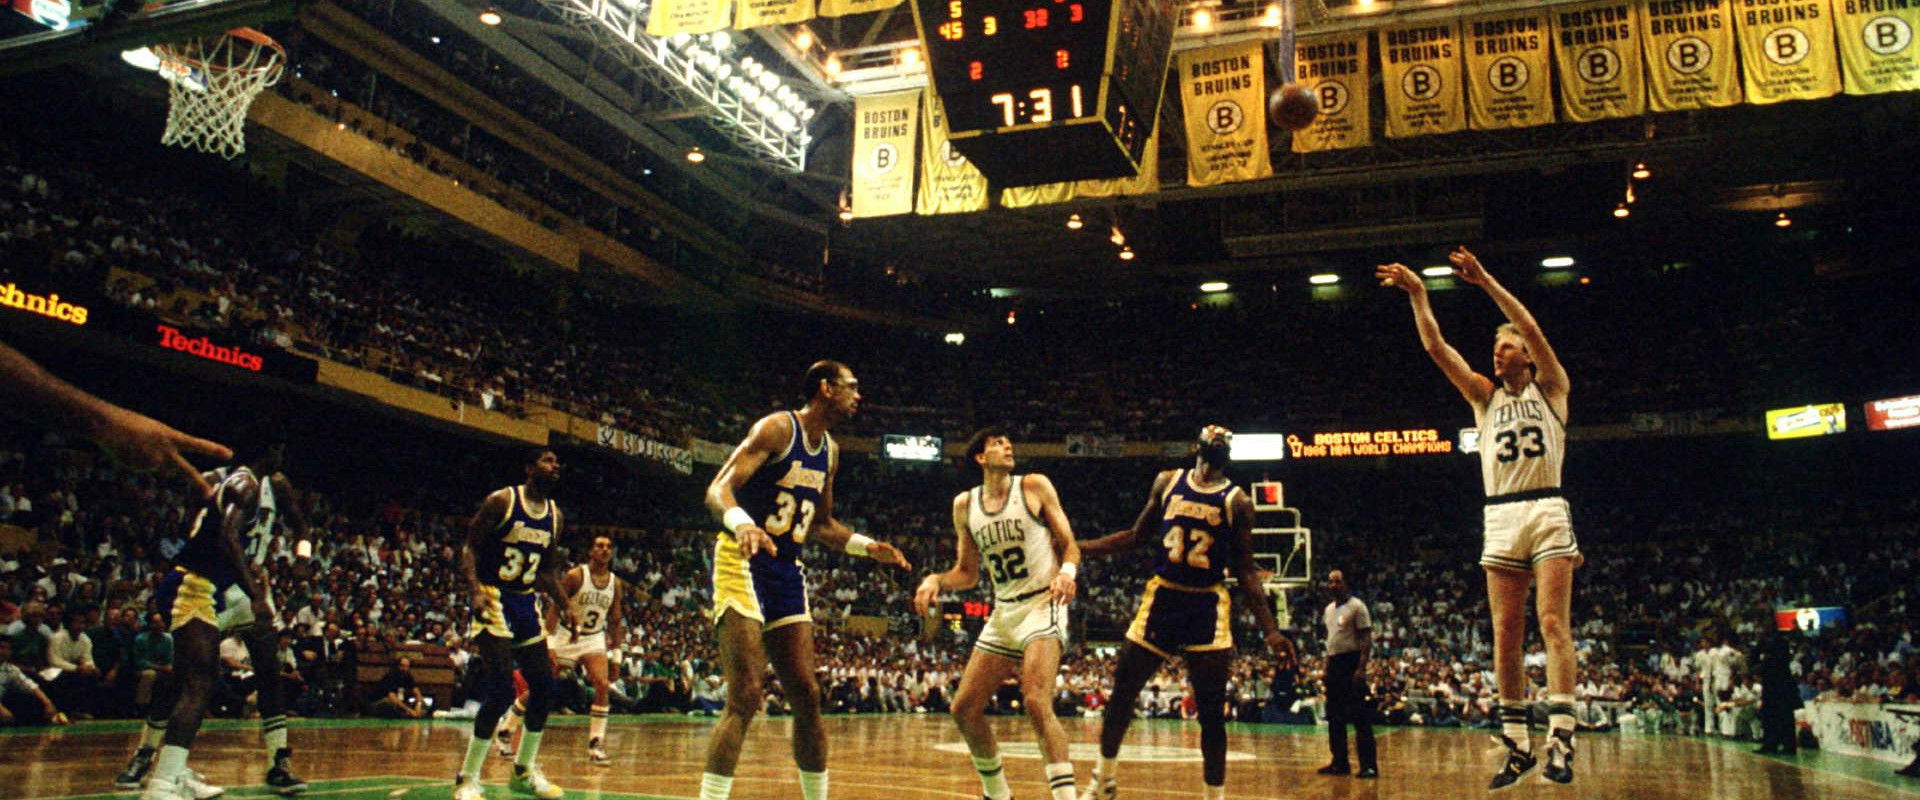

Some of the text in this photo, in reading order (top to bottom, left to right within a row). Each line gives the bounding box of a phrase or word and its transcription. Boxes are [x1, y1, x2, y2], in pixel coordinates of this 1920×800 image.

[1069, 3, 1083, 22] 3
[1560, 5, 1628, 28] BOSTON
[1649, 0, 1719, 16] BOSTON
[1745, 3, 1820, 26] BRUINS
[938, 21, 963, 41] 45
[983, 15, 997, 35] 3
[1387, 25, 1451, 46] BOSTON
[1473, 17, 1539, 37] BOSTON
[1561, 23, 1629, 46] BRUINS
[1651, 13, 1721, 35] BRUINS
[1876, 22, 1898, 48] B
[1297, 41, 1358, 61] BOSTON
[1388, 42, 1453, 65] BRUINS
[1474, 34, 1539, 55] BRUINS
[1680, 42, 1700, 68] B
[1776, 33, 1797, 58] B
[1191, 55, 1250, 78] BOSTON
[1298, 58, 1358, 79] BRUINS
[1499, 62, 1518, 87] B
[1589, 52, 1609, 78] B
[1193, 74, 1252, 97] BRUINS
[1412, 70, 1431, 96] B
[991, 84, 1083, 127] 7:31
[1320, 86, 1339, 109] B
[864, 108, 910, 125] BOSTON
[1216, 106, 1234, 129] B
[863, 122, 909, 140] BRUINS
[877, 147, 891, 169] B
[157, 324, 264, 372] Technics
[1493, 400, 1543, 428] CELTICS
[1314, 429, 1438, 445] BOSTON CELTICS
[1494, 425, 1547, 463] 33
[1353, 443, 1389, 455] WORLD
[764, 490, 816, 544] 33
[976, 518, 1025, 553] CELTICS
[1162, 524, 1215, 570] 42
[498, 546, 541, 585] 32
[988, 546, 1029, 583] 32
[583, 609, 600, 630] 3
